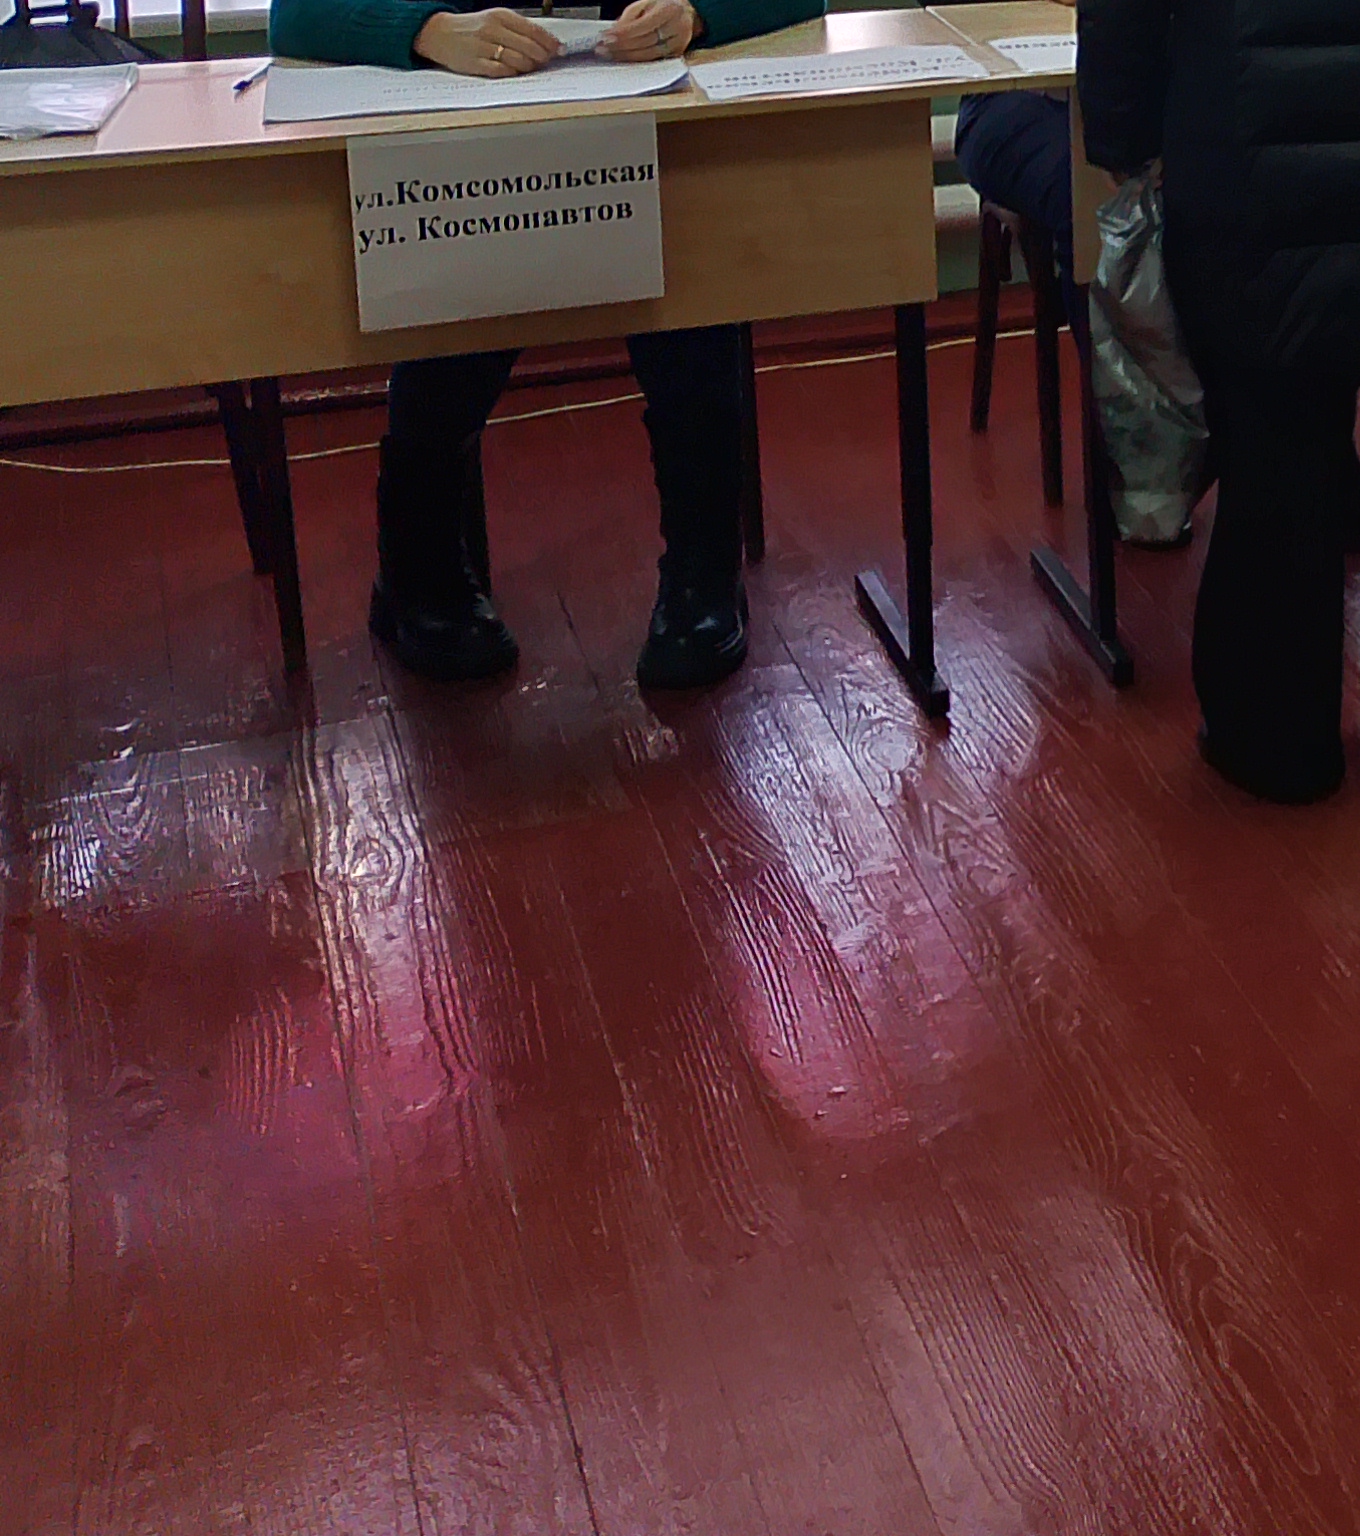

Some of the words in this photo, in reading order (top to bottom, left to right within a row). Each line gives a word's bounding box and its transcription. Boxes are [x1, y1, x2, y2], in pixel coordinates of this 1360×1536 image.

[355, 163, 655, 214] ул.Комсомольская
[358, 226, 407, 255] ул.
[417, 201, 634, 242] Космонавтов
